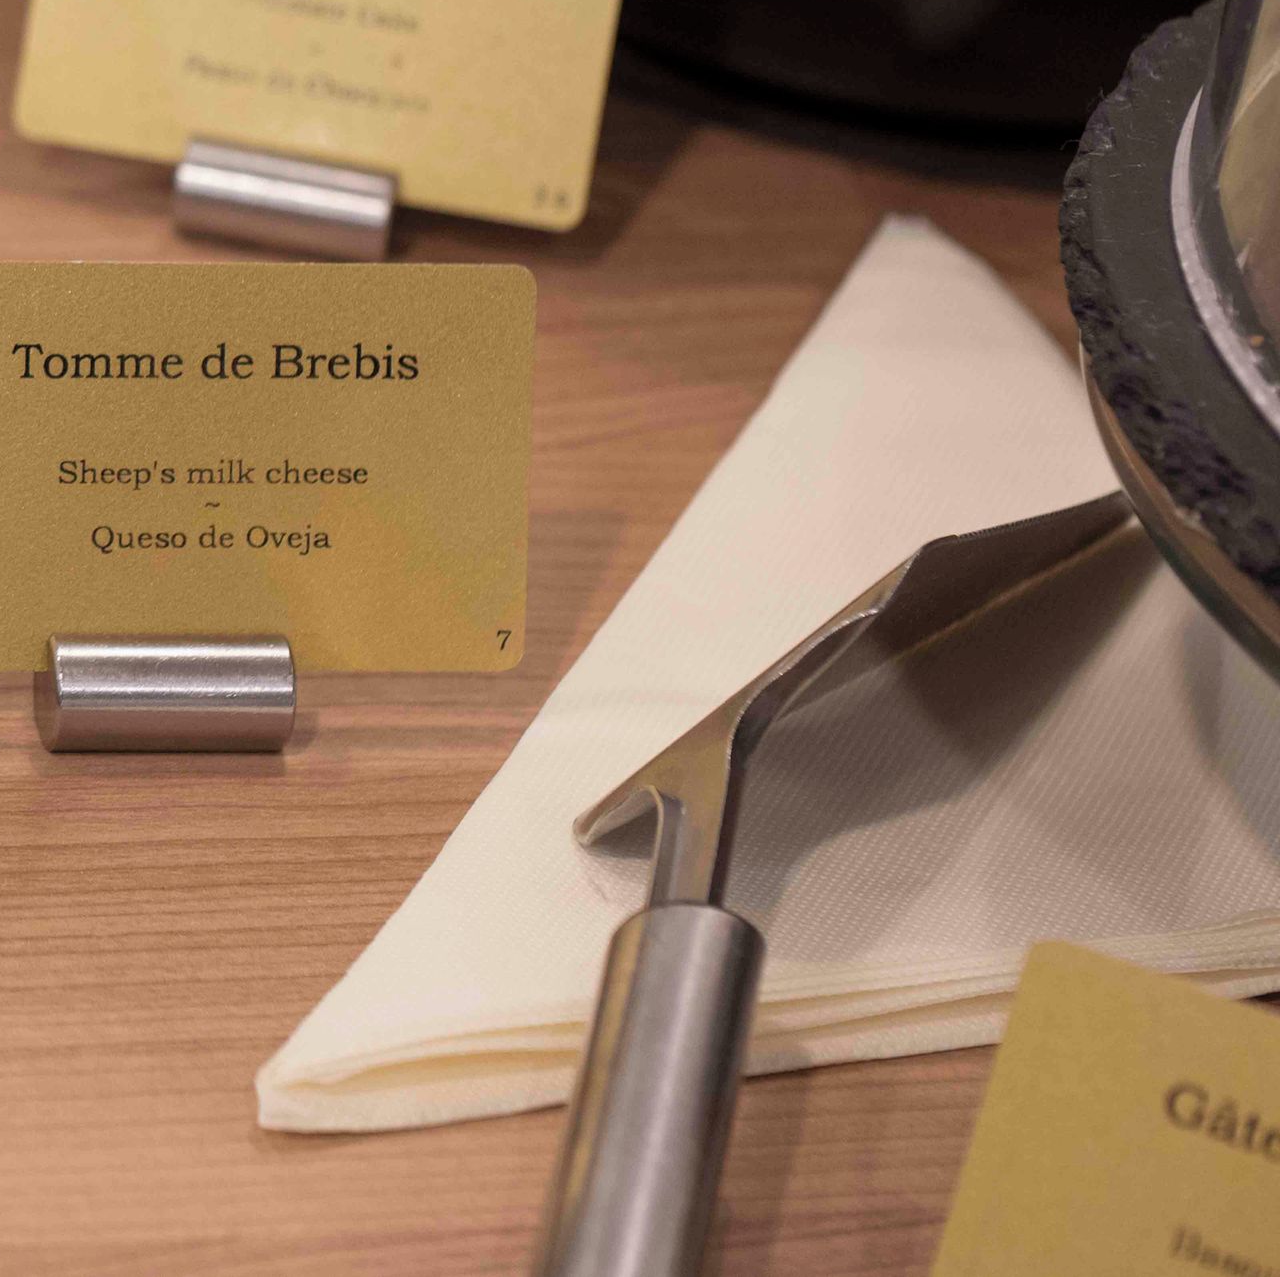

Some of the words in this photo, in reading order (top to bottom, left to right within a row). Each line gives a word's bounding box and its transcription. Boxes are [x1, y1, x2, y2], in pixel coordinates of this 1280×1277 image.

[11, 343, 185, 380] Tomme
[200, 342, 254, 380] de
[271, 342, 420, 381] Brebis
[57, 459, 176, 490] Sheep's
[187, 460, 253, 484] milk
[265, 460, 369, 484] cheese
[90, 525, 187, 555] Queso
[198, 525, 234, 548] de
[246, 526, 331, 556] Oveja
[496, 629, 512, 651] 7
[1162, 1080, 1280, 1164] Gâte
